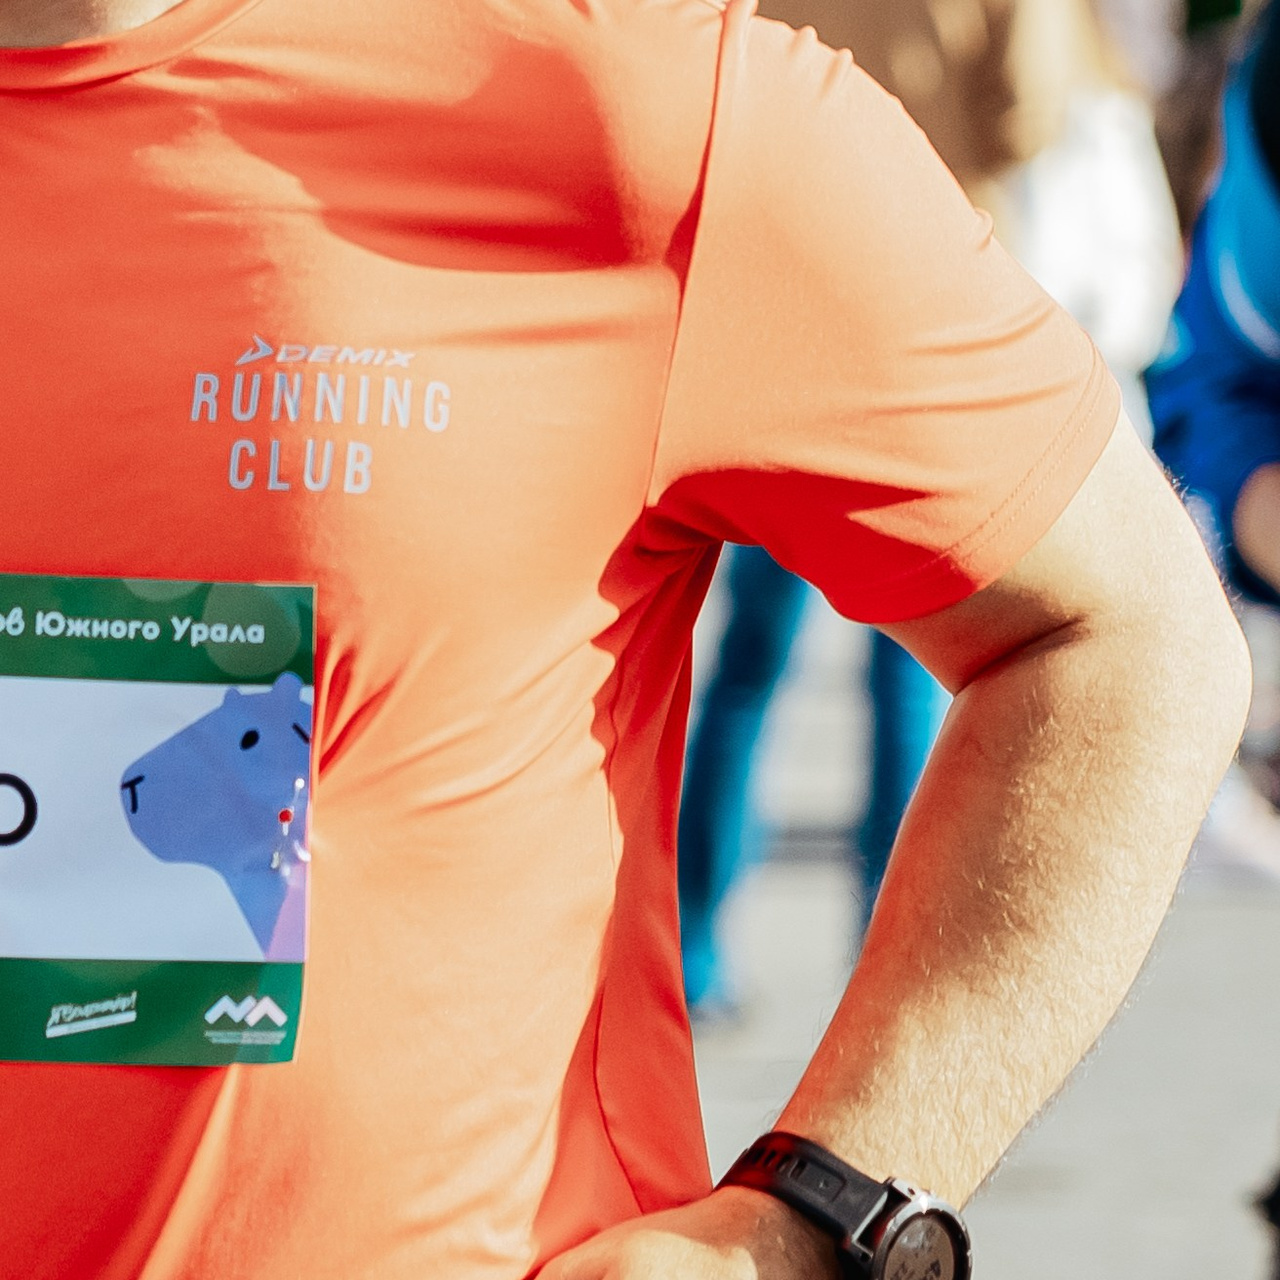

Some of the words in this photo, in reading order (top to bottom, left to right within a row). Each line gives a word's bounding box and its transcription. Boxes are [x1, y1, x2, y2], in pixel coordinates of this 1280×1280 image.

[276, 343, 417, 368] DEMIX
[189, 372, 451, 433] RUNNING
[227, 437, 374, 495] CLUB
[34, 608, 161, 642] Южного
[170, 614, 266, 648] Урала
